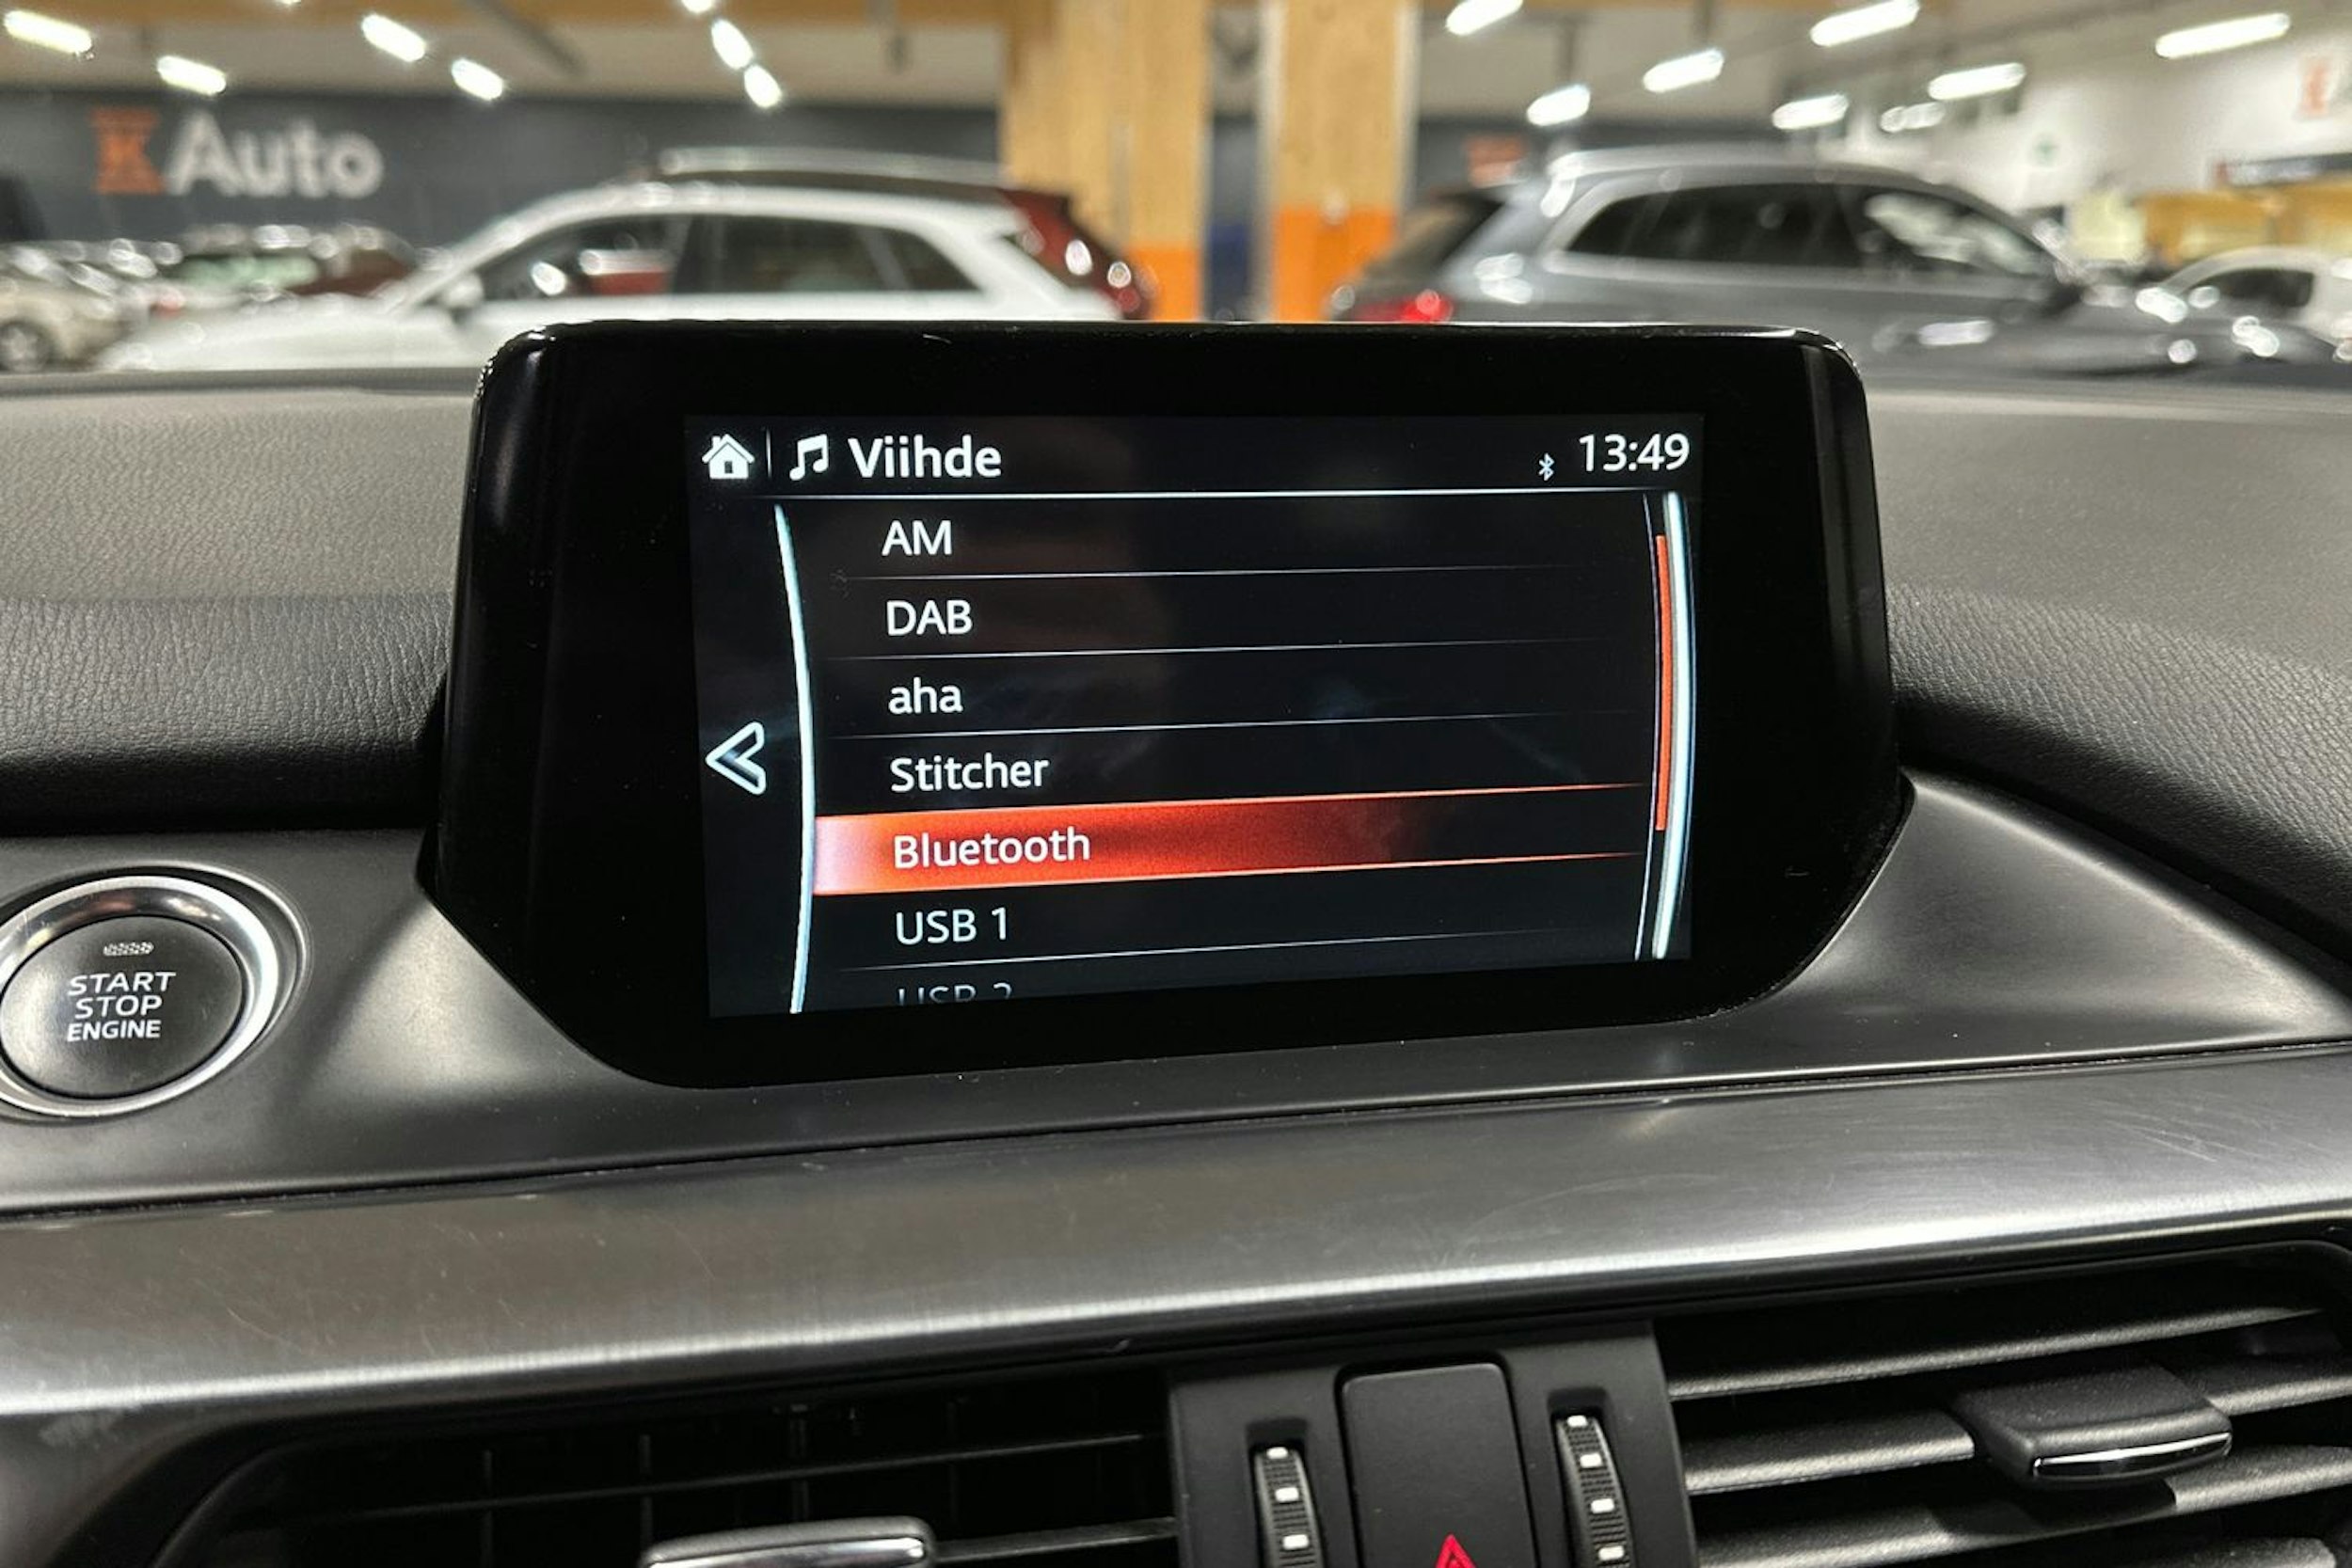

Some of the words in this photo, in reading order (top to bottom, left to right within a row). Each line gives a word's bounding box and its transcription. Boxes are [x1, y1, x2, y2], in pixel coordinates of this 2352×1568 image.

[848, 434, 1002, 478] Viihde
[1579, 433, 1690, 472] 13:49
[882, 519, 952, 557] AM
[886, 599, 973, 637] DAB
[888, 677, 963, 715] aha
[890, 752, 1050, 792] Stitcher
[893, 827, 1090, 869] Bluetooth
[896, 909, 977, 945] USB
[991, 907, 1007, 941] 1
[67, 971, 177, 997] START
[74, 994, 163, 1020] STOP
[66, 1019, 162, 1043] ENGINE
